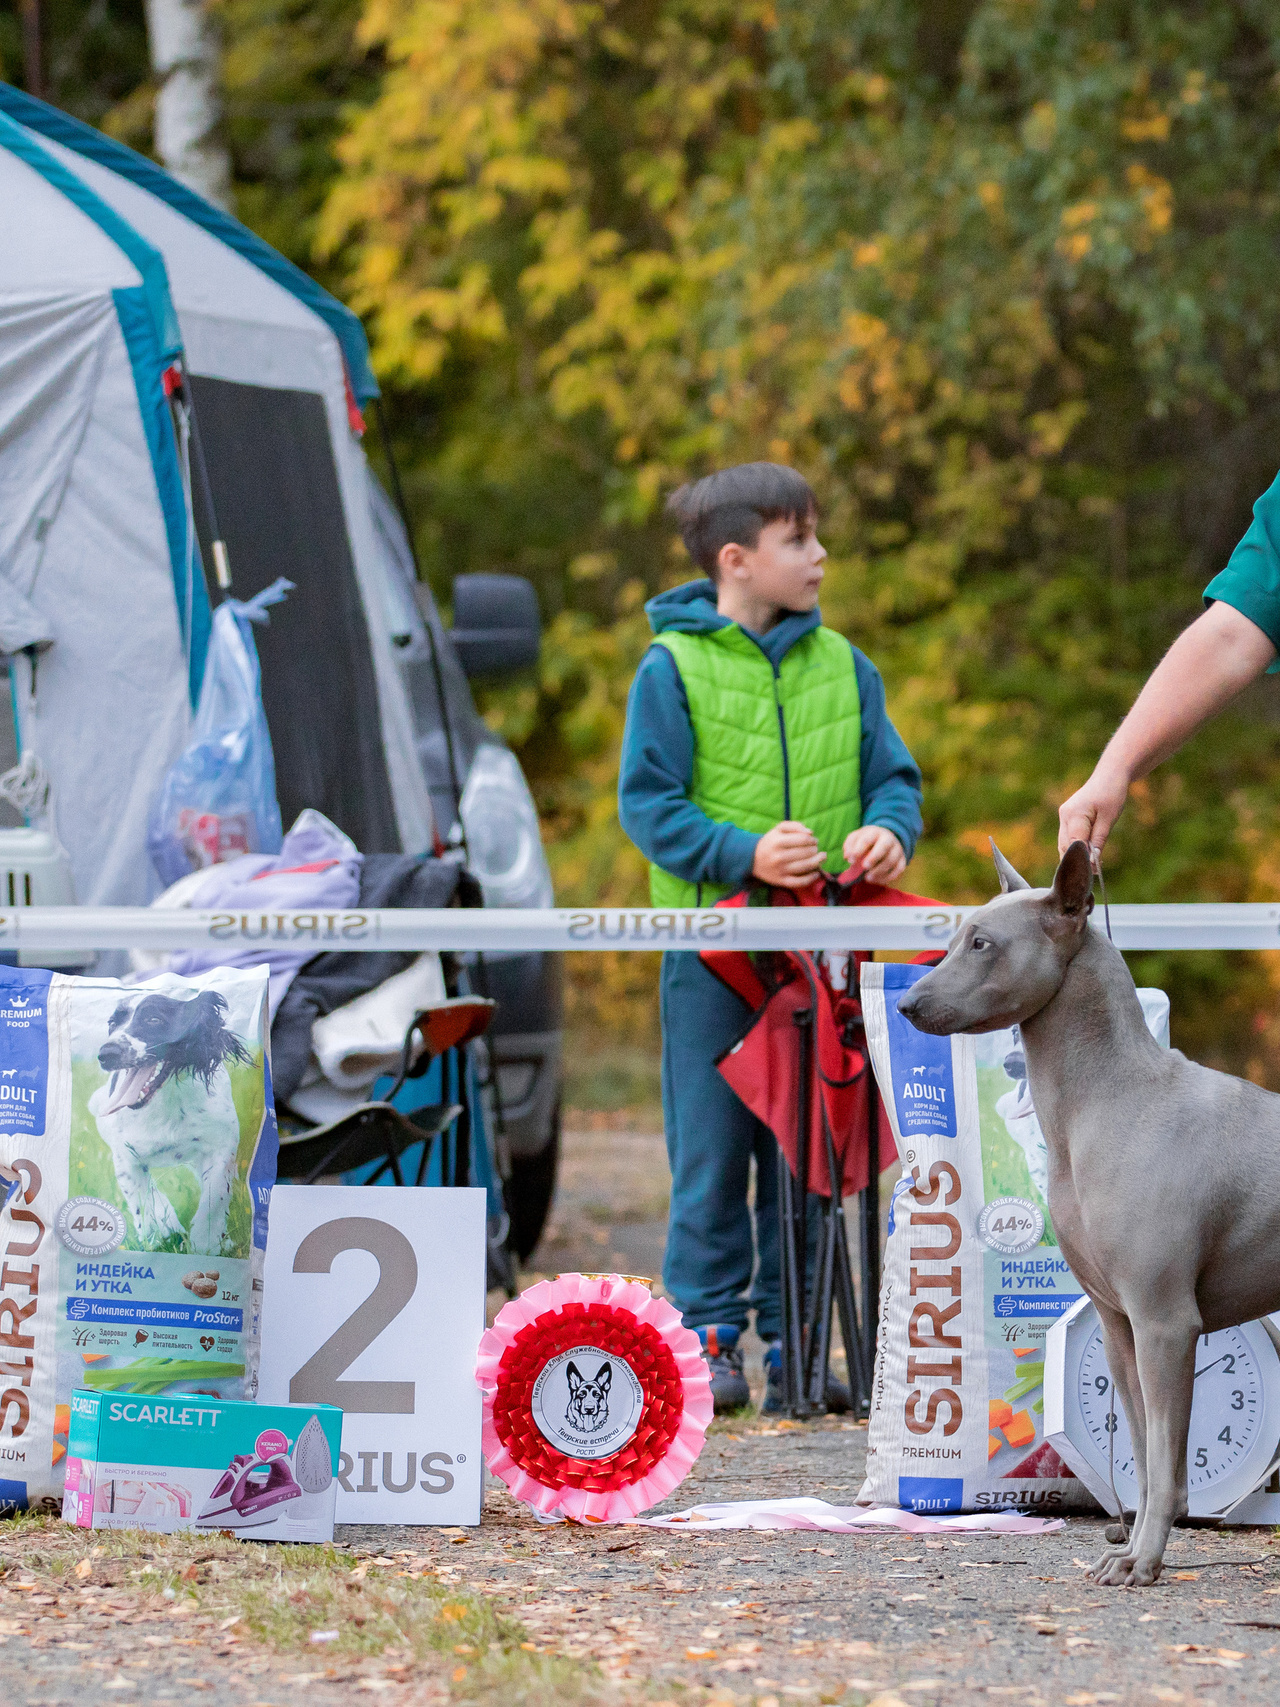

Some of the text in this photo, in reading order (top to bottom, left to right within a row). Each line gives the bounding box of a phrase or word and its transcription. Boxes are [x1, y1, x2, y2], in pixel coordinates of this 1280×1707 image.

[0, 1008, 42, 1019] REMIUM
[0, 1085, 38, 1104] DULT
[903, 1083, 946, 1103] ADULT
[71, 1216, 113, 1232] 44%
[991, 1216, 1032, 1233] 44%
[76, 1262, 155, 1280] ИНДЕЙКА
[75, 1279, 132, 1295] И УТКА
[1002, 1276, 1056, 1288] И УТКА
[91, 1304, 190, 1321] Комплекс пробиотиков
[1018, 1300, 1060, 1310] Комплекс
[194, 1310, 240, 1325] ProStor+
[289, 1216, 418, 1414] 2
[1028, 1322, 1052, 1330] Здоров
[1222, 1354, 1236, 1374] 2
[1095, 1375, 1109, 1396] 9
[1231, 1389, 1245, 1411] 3
[109, 1402, 222, 1427] SCARLETT
[1105, 1412, 1118, 1433] 8
[557, 1427, 588, 1445] Тверские
[1217, 1425, 1232, 1445] 4
[902, 1447, 962, 1460] PREMIUM
[1194, 1447, 1208, 1468] 5
[975, 1490, 1063, 1505] SIRIUS
